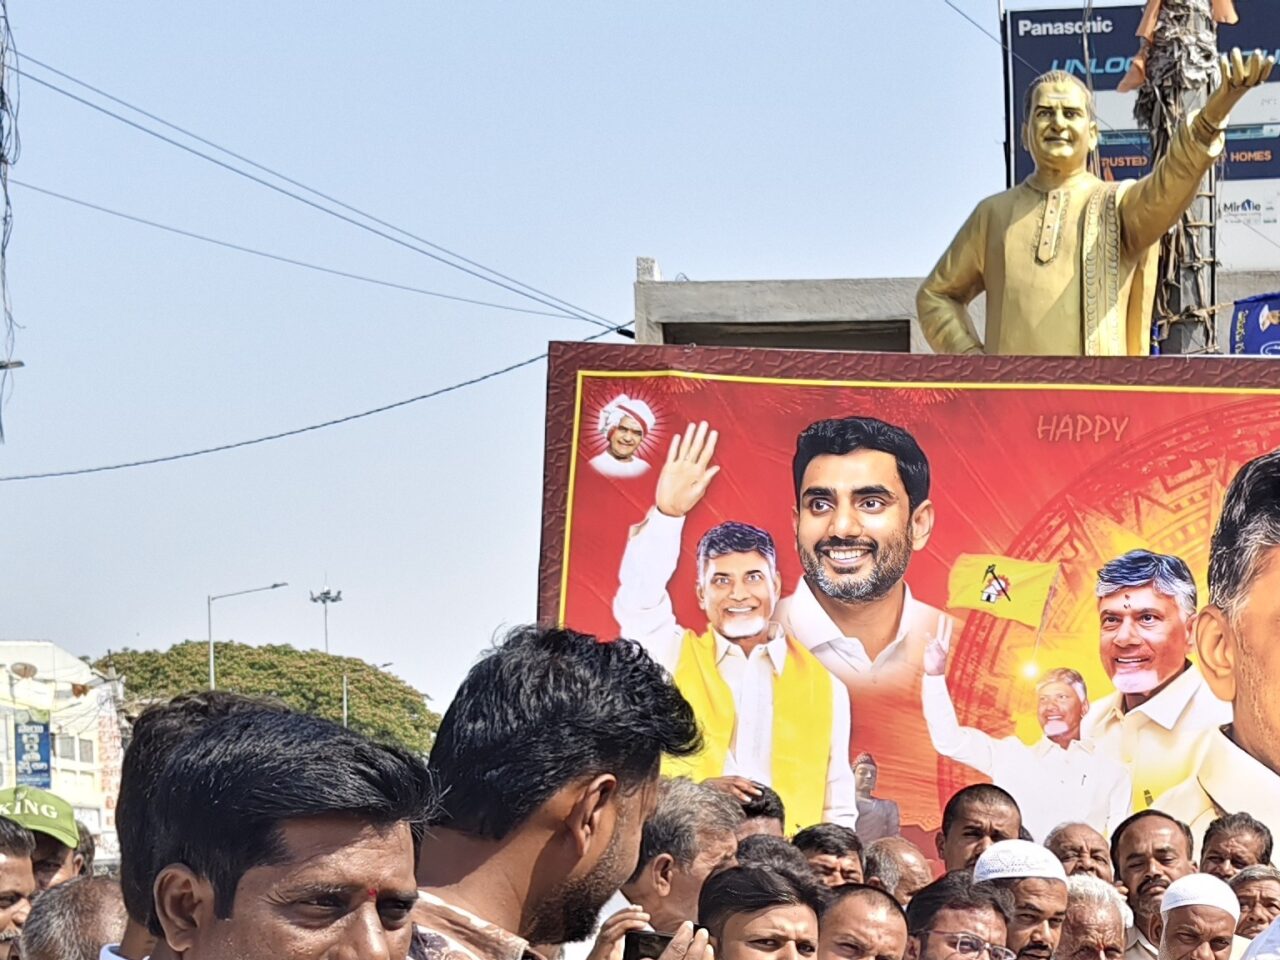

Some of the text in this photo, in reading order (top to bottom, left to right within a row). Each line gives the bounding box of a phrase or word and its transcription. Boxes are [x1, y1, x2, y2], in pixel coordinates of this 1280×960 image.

[1018, 16, 1113, 36] Panasonic
[1230, 150, 1272, 162] HOMES
[1037, 414, 1129, 443] HAPPY
